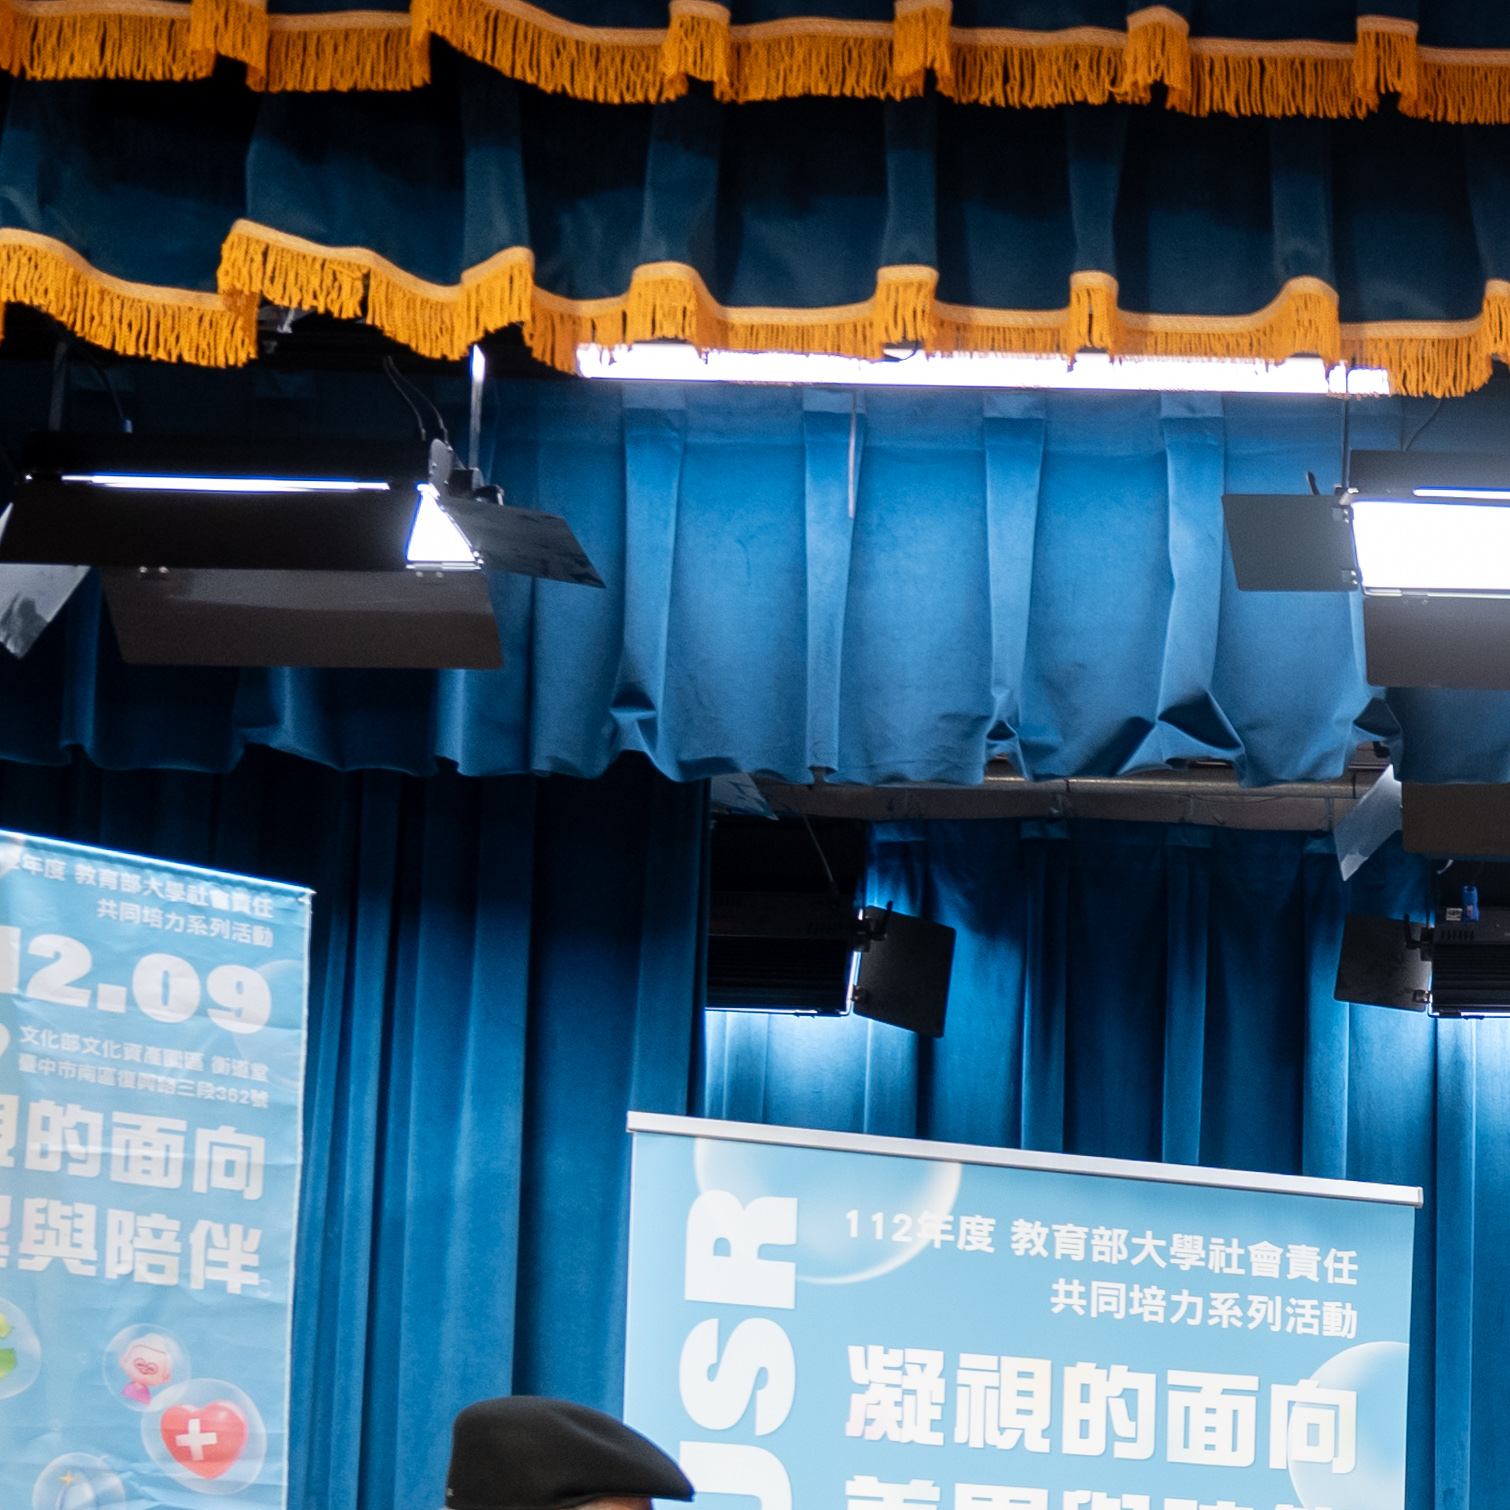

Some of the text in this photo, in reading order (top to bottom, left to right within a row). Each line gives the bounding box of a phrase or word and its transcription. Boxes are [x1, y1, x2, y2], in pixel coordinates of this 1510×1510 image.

[14, 853, 274, 918] 年度 教育部大學社會責任
[97, 899, 274, 948] 共同培力系列活動
[844, 1208, 1359, 1287] 112年度 教育部大學社會責任
[1050, 1277, 1358, 1340] 共同培力系列活動
[845, 1343, 1358, 1476] 凝視的面向
